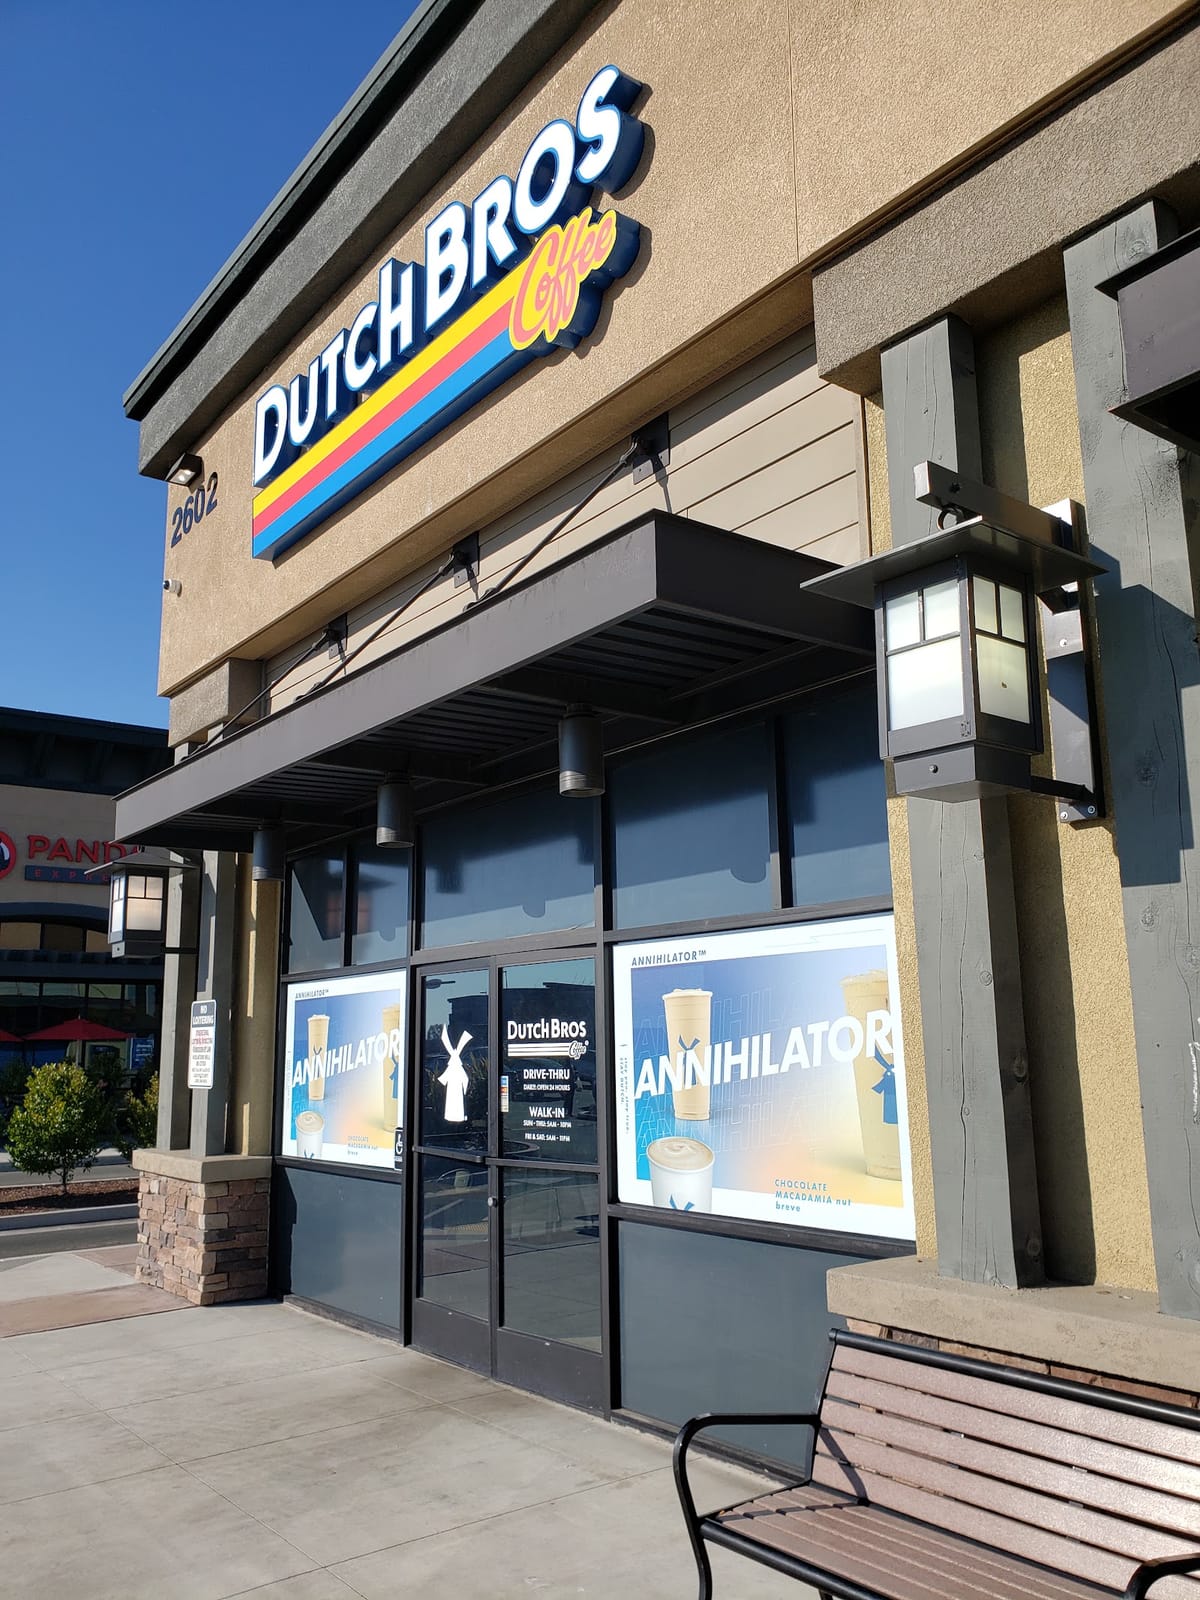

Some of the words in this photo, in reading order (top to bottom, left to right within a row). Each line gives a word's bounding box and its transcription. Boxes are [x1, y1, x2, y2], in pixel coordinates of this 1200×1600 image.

[425, 64, 624, 334] BROS
[511, 209, 615, 347] Coffee
[170, 471, 218, 549] 2602
[27, 834, 139, 864] PAND
[550, 1018, 587, 1038] BROS
[292, 1028, 400, 1088] ANNIHILATOR
[569, 1040, 587, 1060] Coffee
[634, 1009, 895, 1099] ANNIHILATOR
[523, 1068, 570, 1080] DRIVE-THRU
[529, 1106, 565, 1119] WALK-IN
[774, 1179, 828, 1192] CHOCOLATE
[775, 1191, 832, 1204] MACADAMIA
[835, 1198, 851, 1206] nut
[775, 1201, 801, 1212] breve
